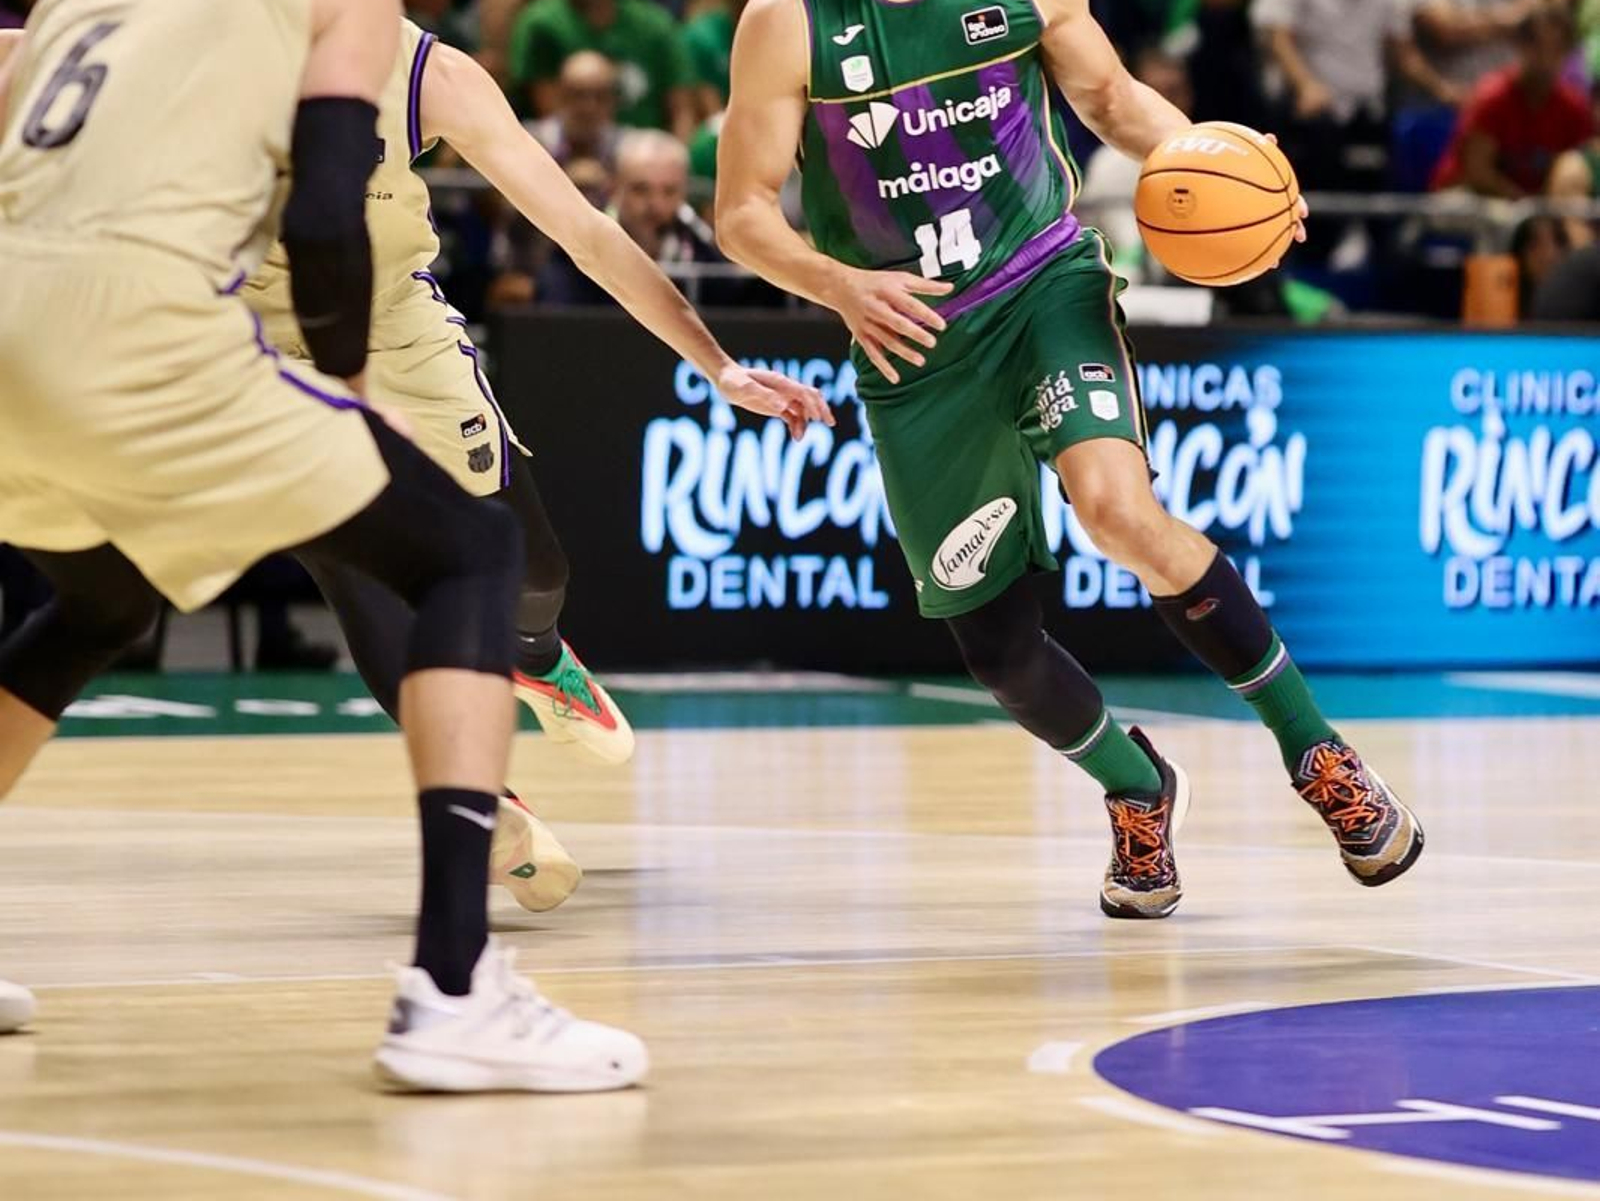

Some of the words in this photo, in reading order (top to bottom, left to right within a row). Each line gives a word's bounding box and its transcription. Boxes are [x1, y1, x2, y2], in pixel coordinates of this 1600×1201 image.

[22, 21, 120, 149] 6
[902, 85, 1012, 136] Unicaja
[914, 207, 982, 279] 14
[1135, 363, 1283, 411] NICAS
[1451, 368, 1600, 415] CLINIC
[1419, 405, 1600, 559] RINC
[667, 555, 889, 610] DENTAL
[1443, 556, 1600, 607] DENTA
